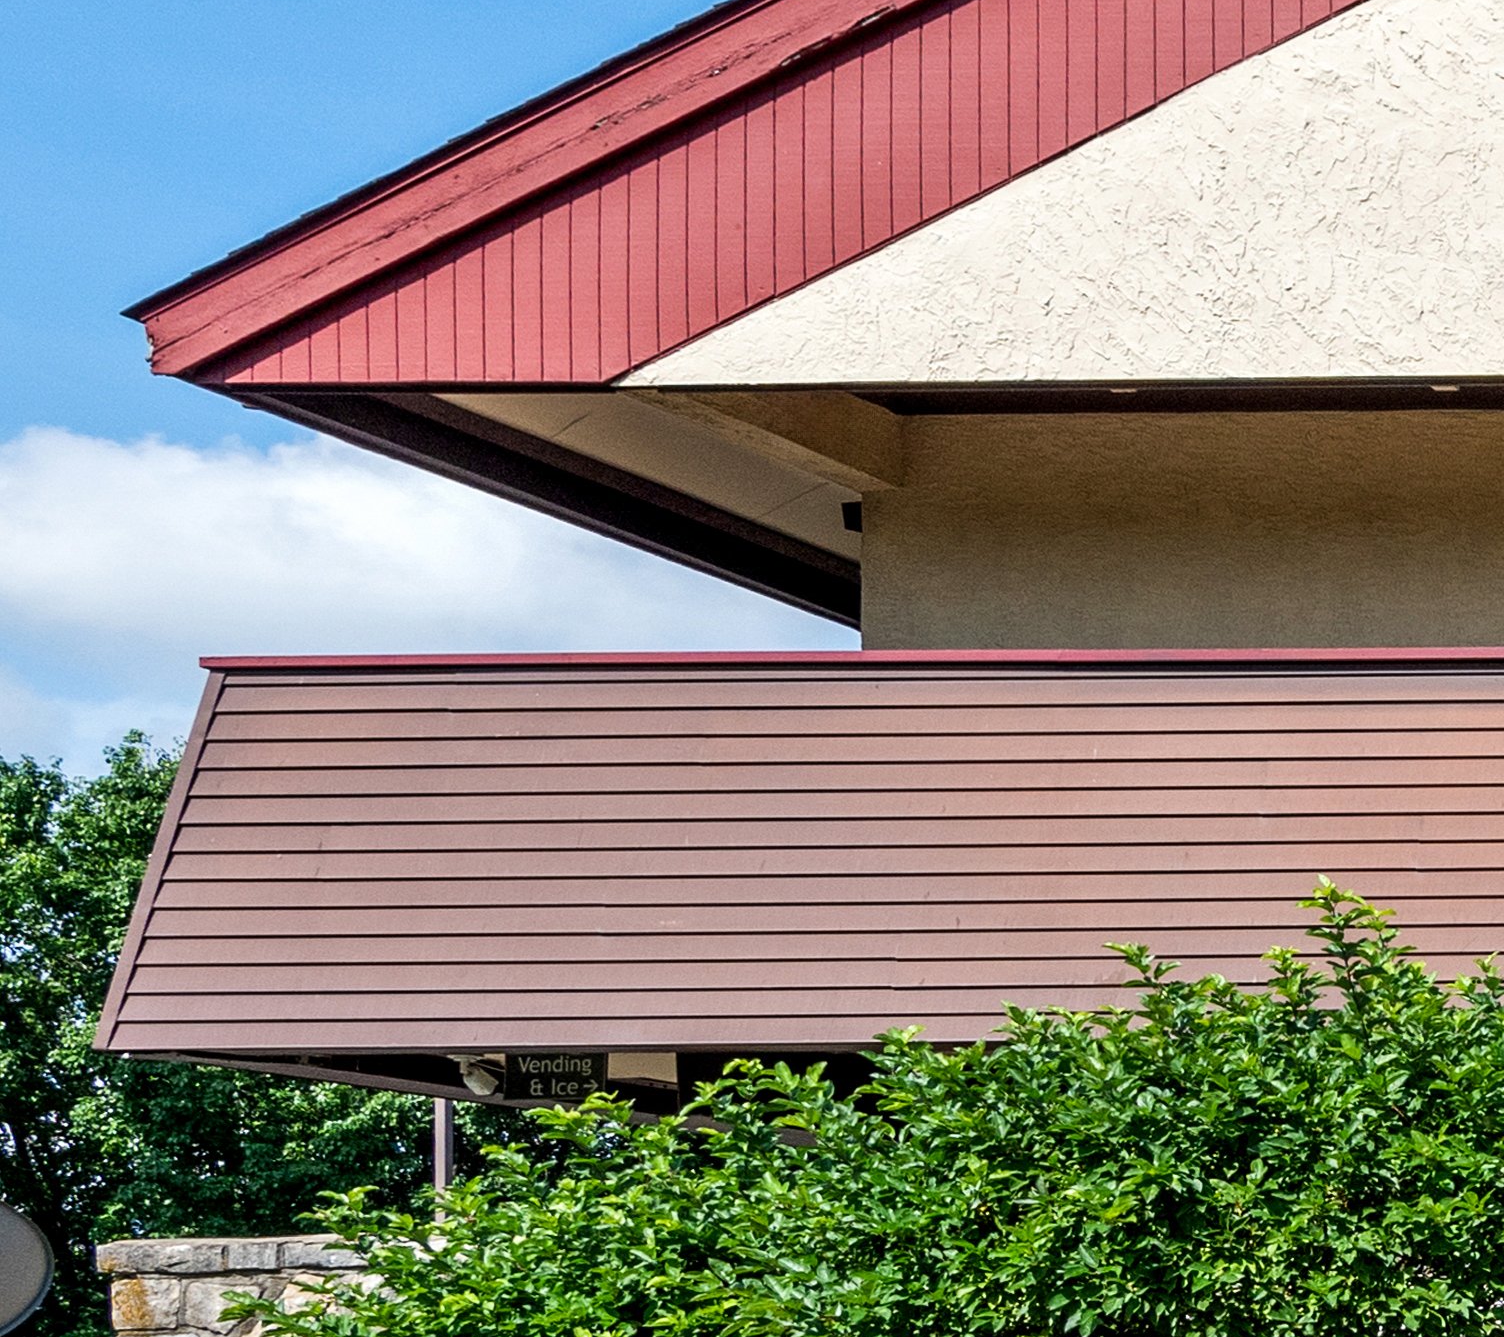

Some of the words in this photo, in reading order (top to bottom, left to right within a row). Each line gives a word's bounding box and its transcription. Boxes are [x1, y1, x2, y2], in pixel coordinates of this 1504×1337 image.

[518, 1056, 592, 1076] Vending
[530, 1079, 544, 1096] &
[551, 1079, 579, 1095] Ice
